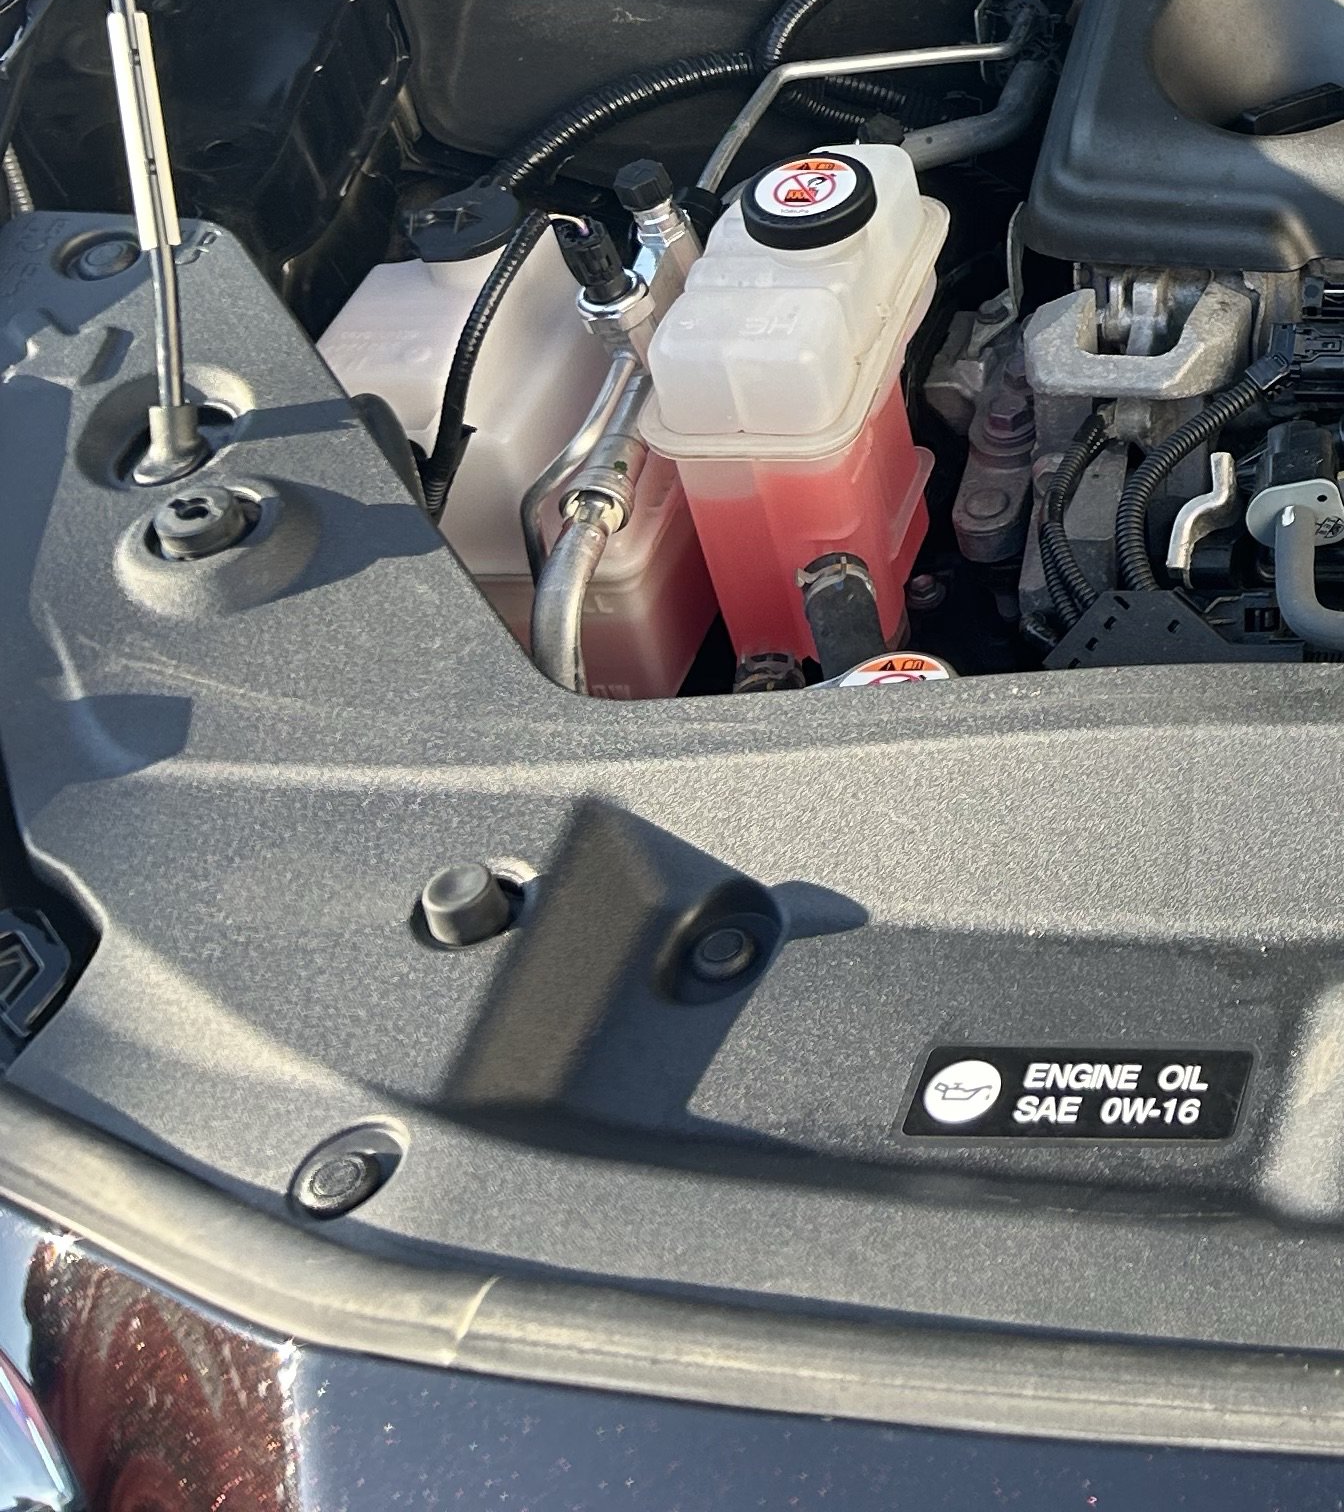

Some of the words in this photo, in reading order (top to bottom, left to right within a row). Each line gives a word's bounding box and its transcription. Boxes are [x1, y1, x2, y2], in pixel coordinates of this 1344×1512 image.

[1022, 1062, 1143, 1091] ENGINE
[1157, 1064, 1210, 1092] OIL
[1012, 1095, 1083, 1124] SAE
[1099, 1097, 1202, 1125] 0W-16
